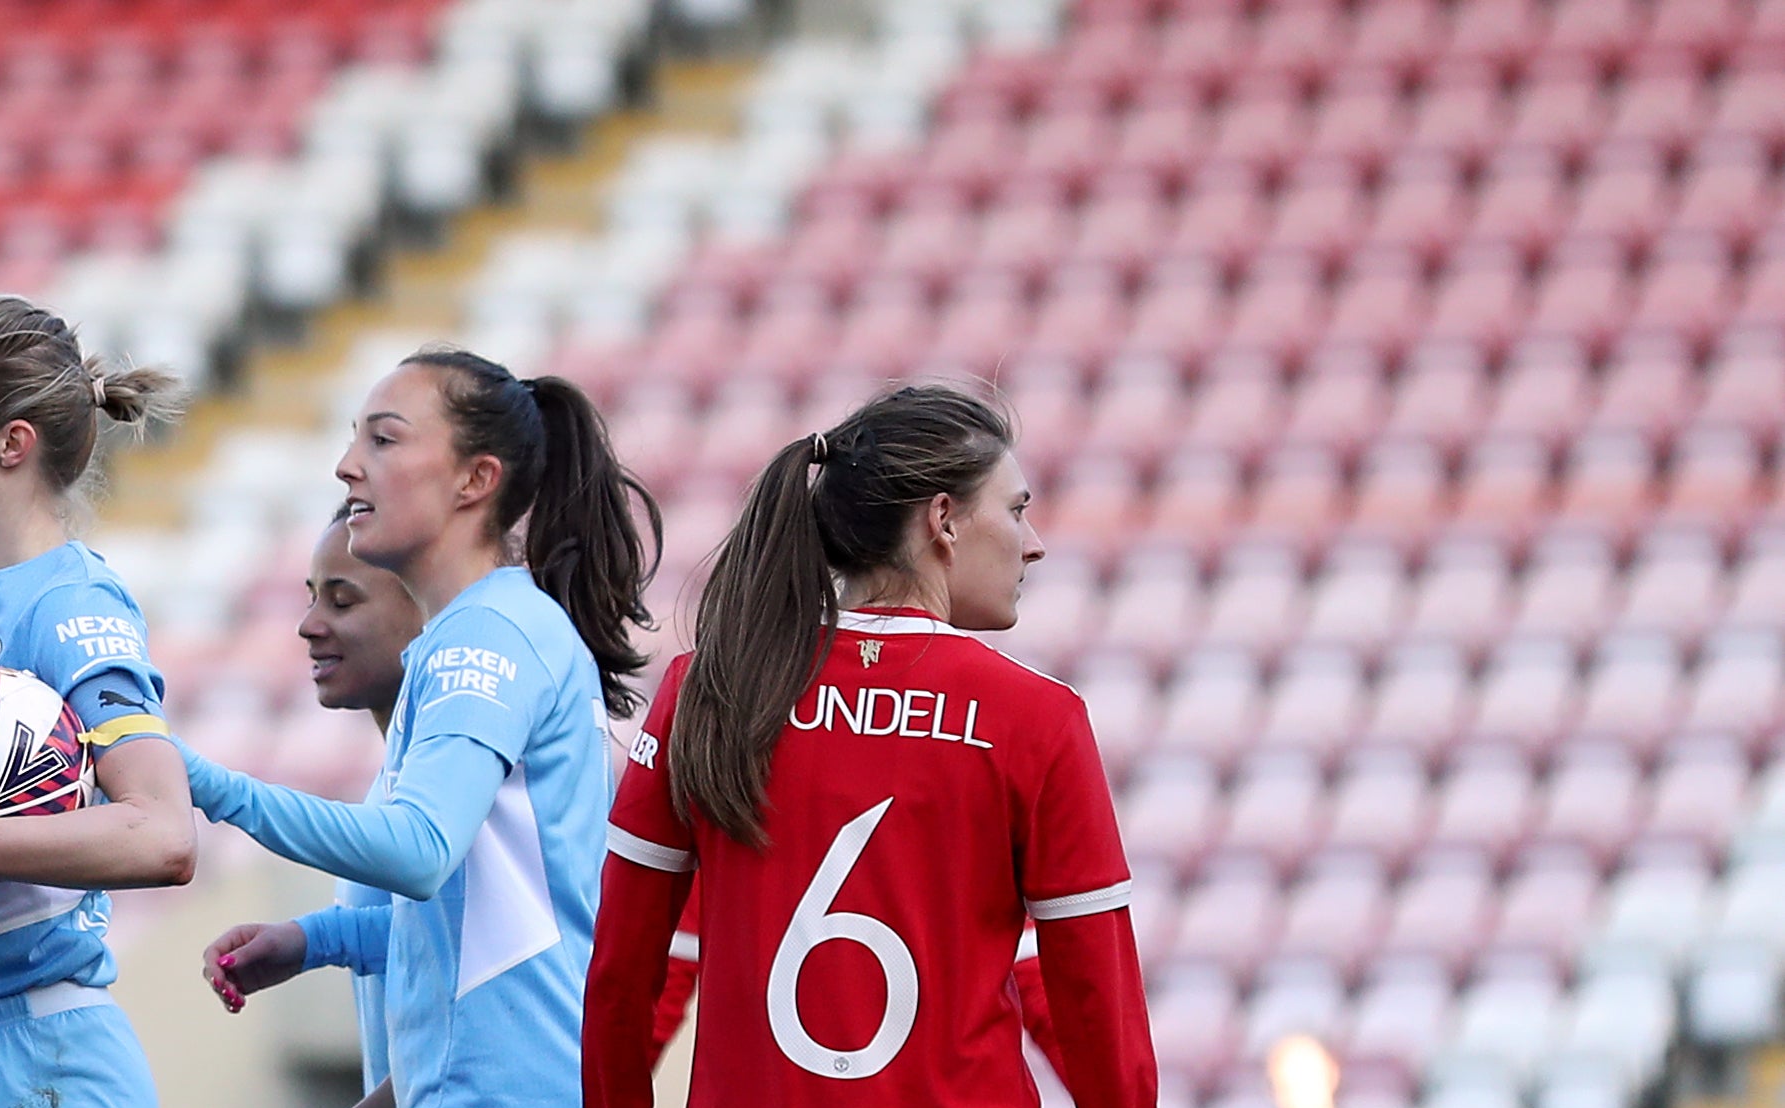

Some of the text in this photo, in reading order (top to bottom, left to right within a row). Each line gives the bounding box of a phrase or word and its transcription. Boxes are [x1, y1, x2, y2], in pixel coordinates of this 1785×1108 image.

[55, 615, 145, 647] NEXEN
[76, 636, 142, 660] TIRE
[428, 646, 517, 682] NEXEN
[436, 668, 500, 697] TIRE
[786, 684, 994, 749] UNDELL
[766, 796, 920, 1080] 6
